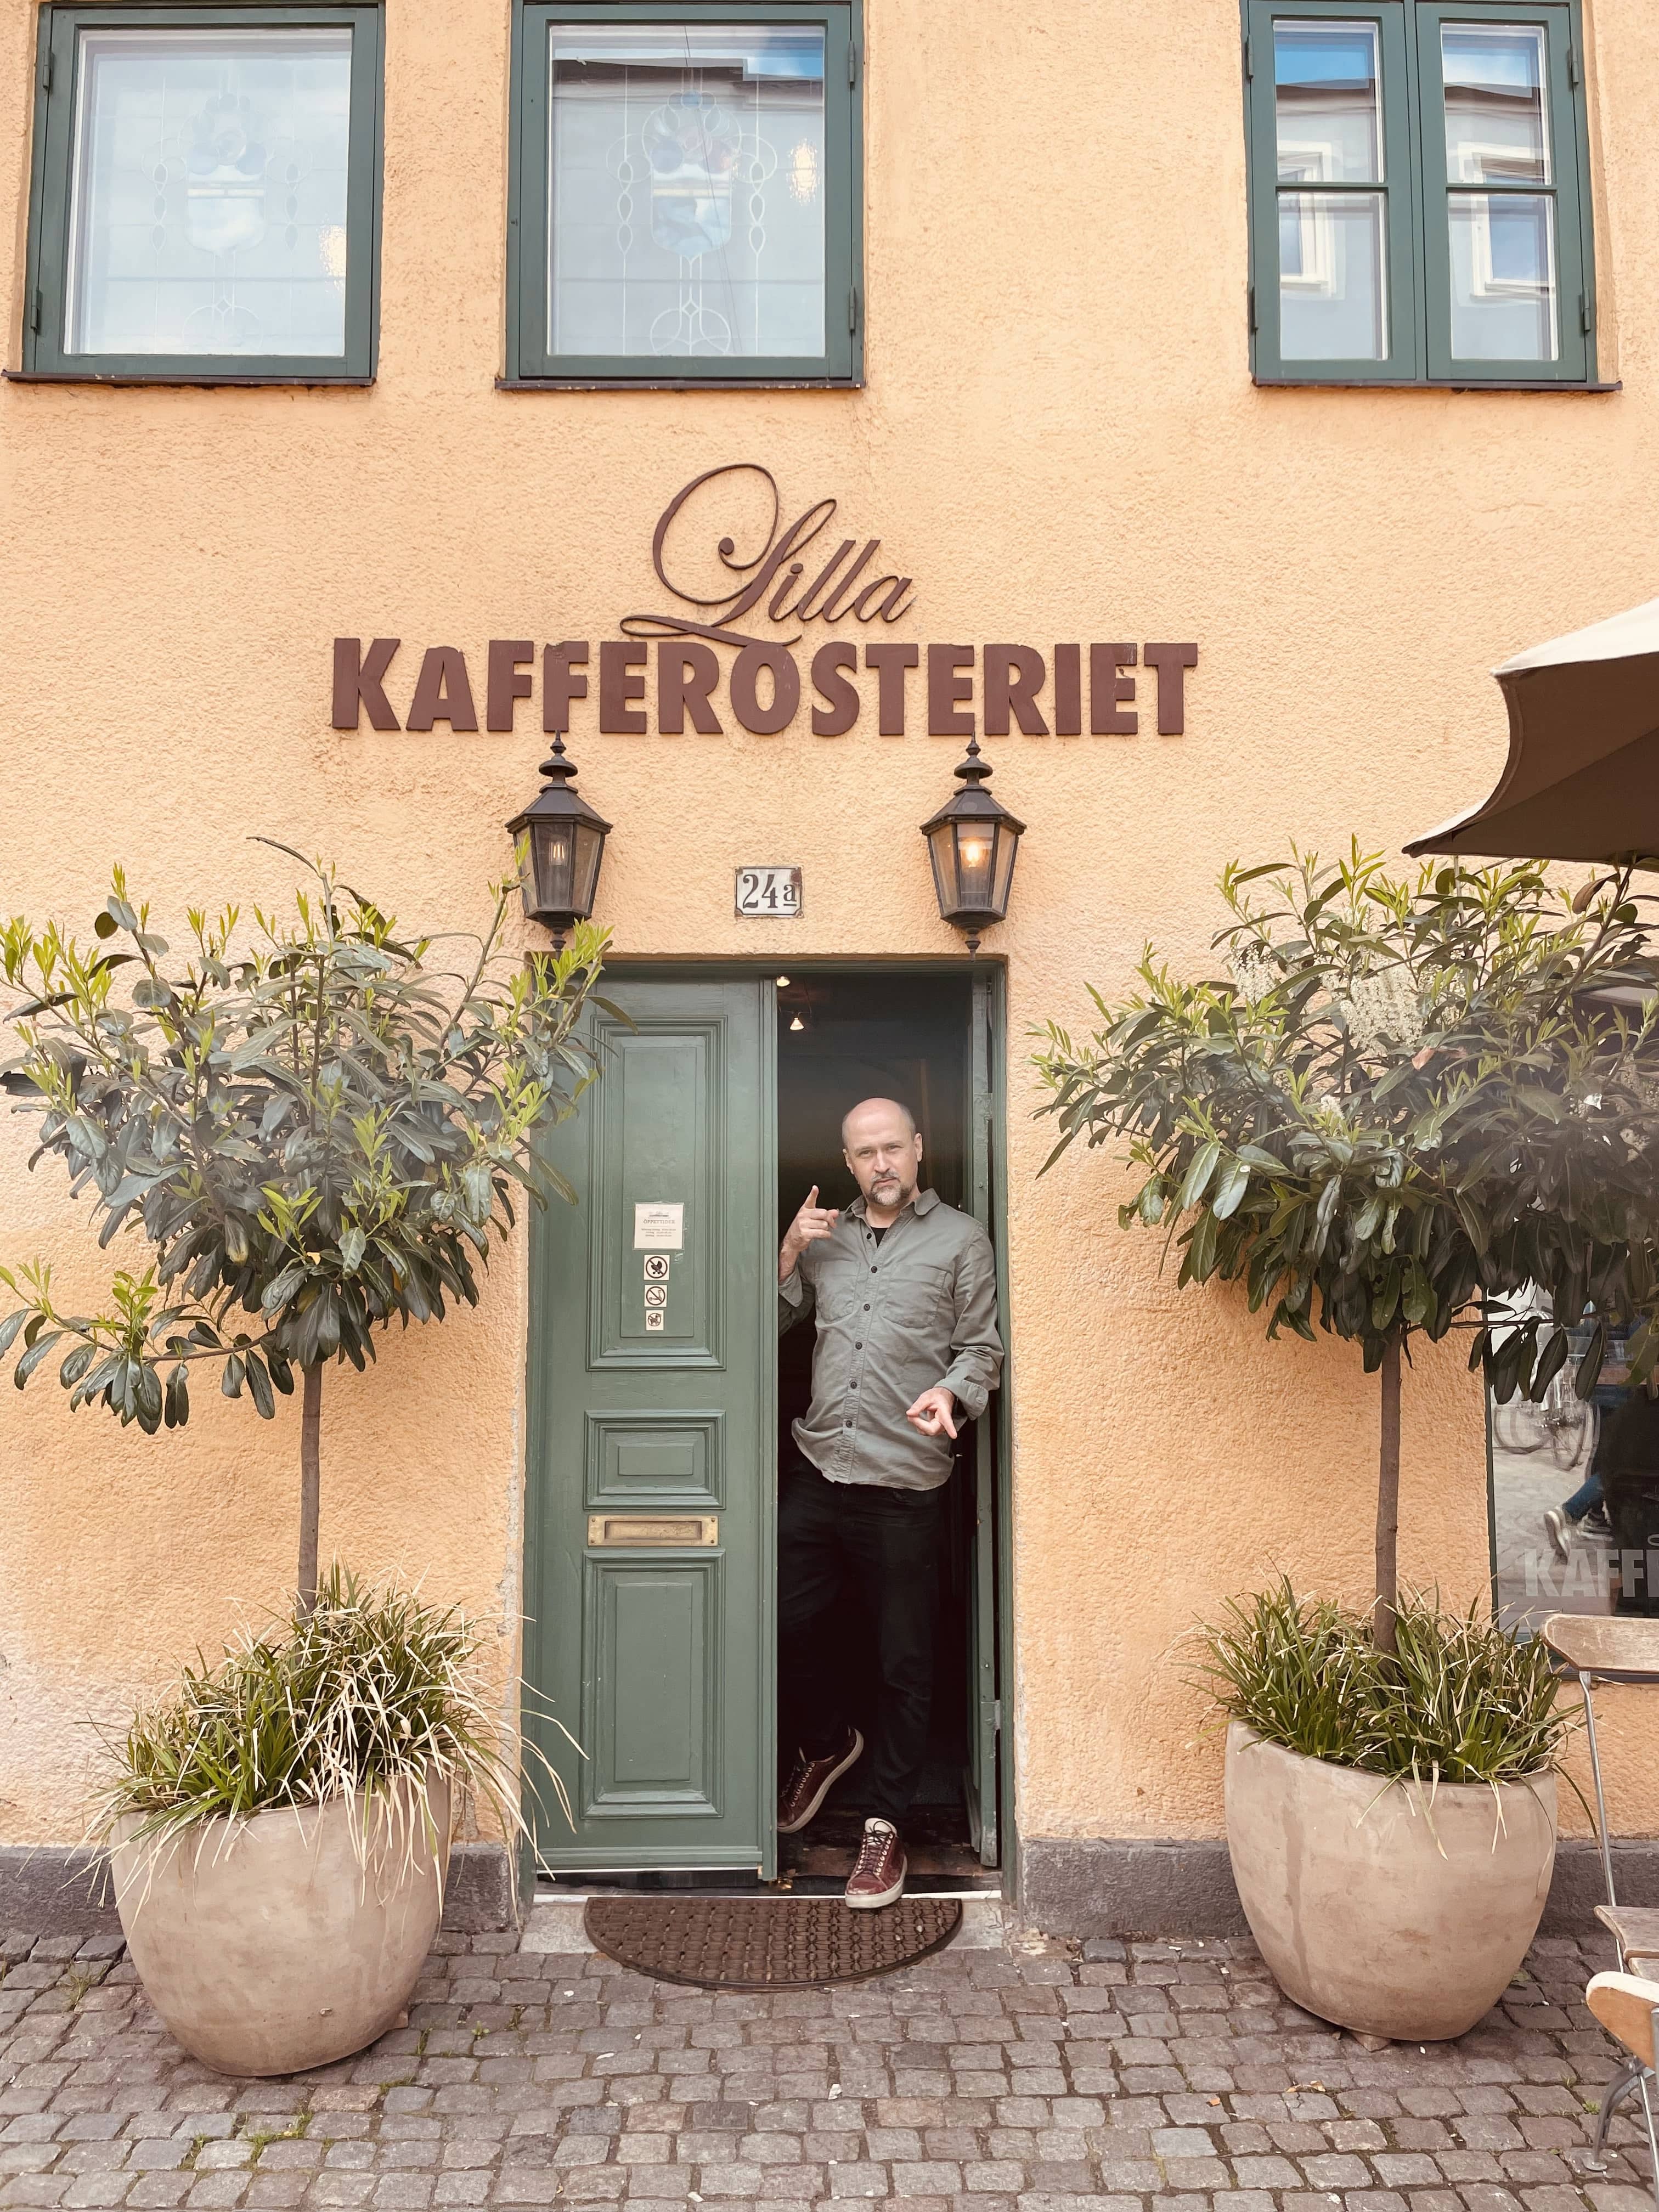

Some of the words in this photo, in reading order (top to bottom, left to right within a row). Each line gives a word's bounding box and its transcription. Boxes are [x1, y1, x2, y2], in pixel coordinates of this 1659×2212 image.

[620, 464, 916, 646] Lilla
[332, 638, 1198, 736] KAFFEROSTERIET
[742, 874, 797, 909] 24a
